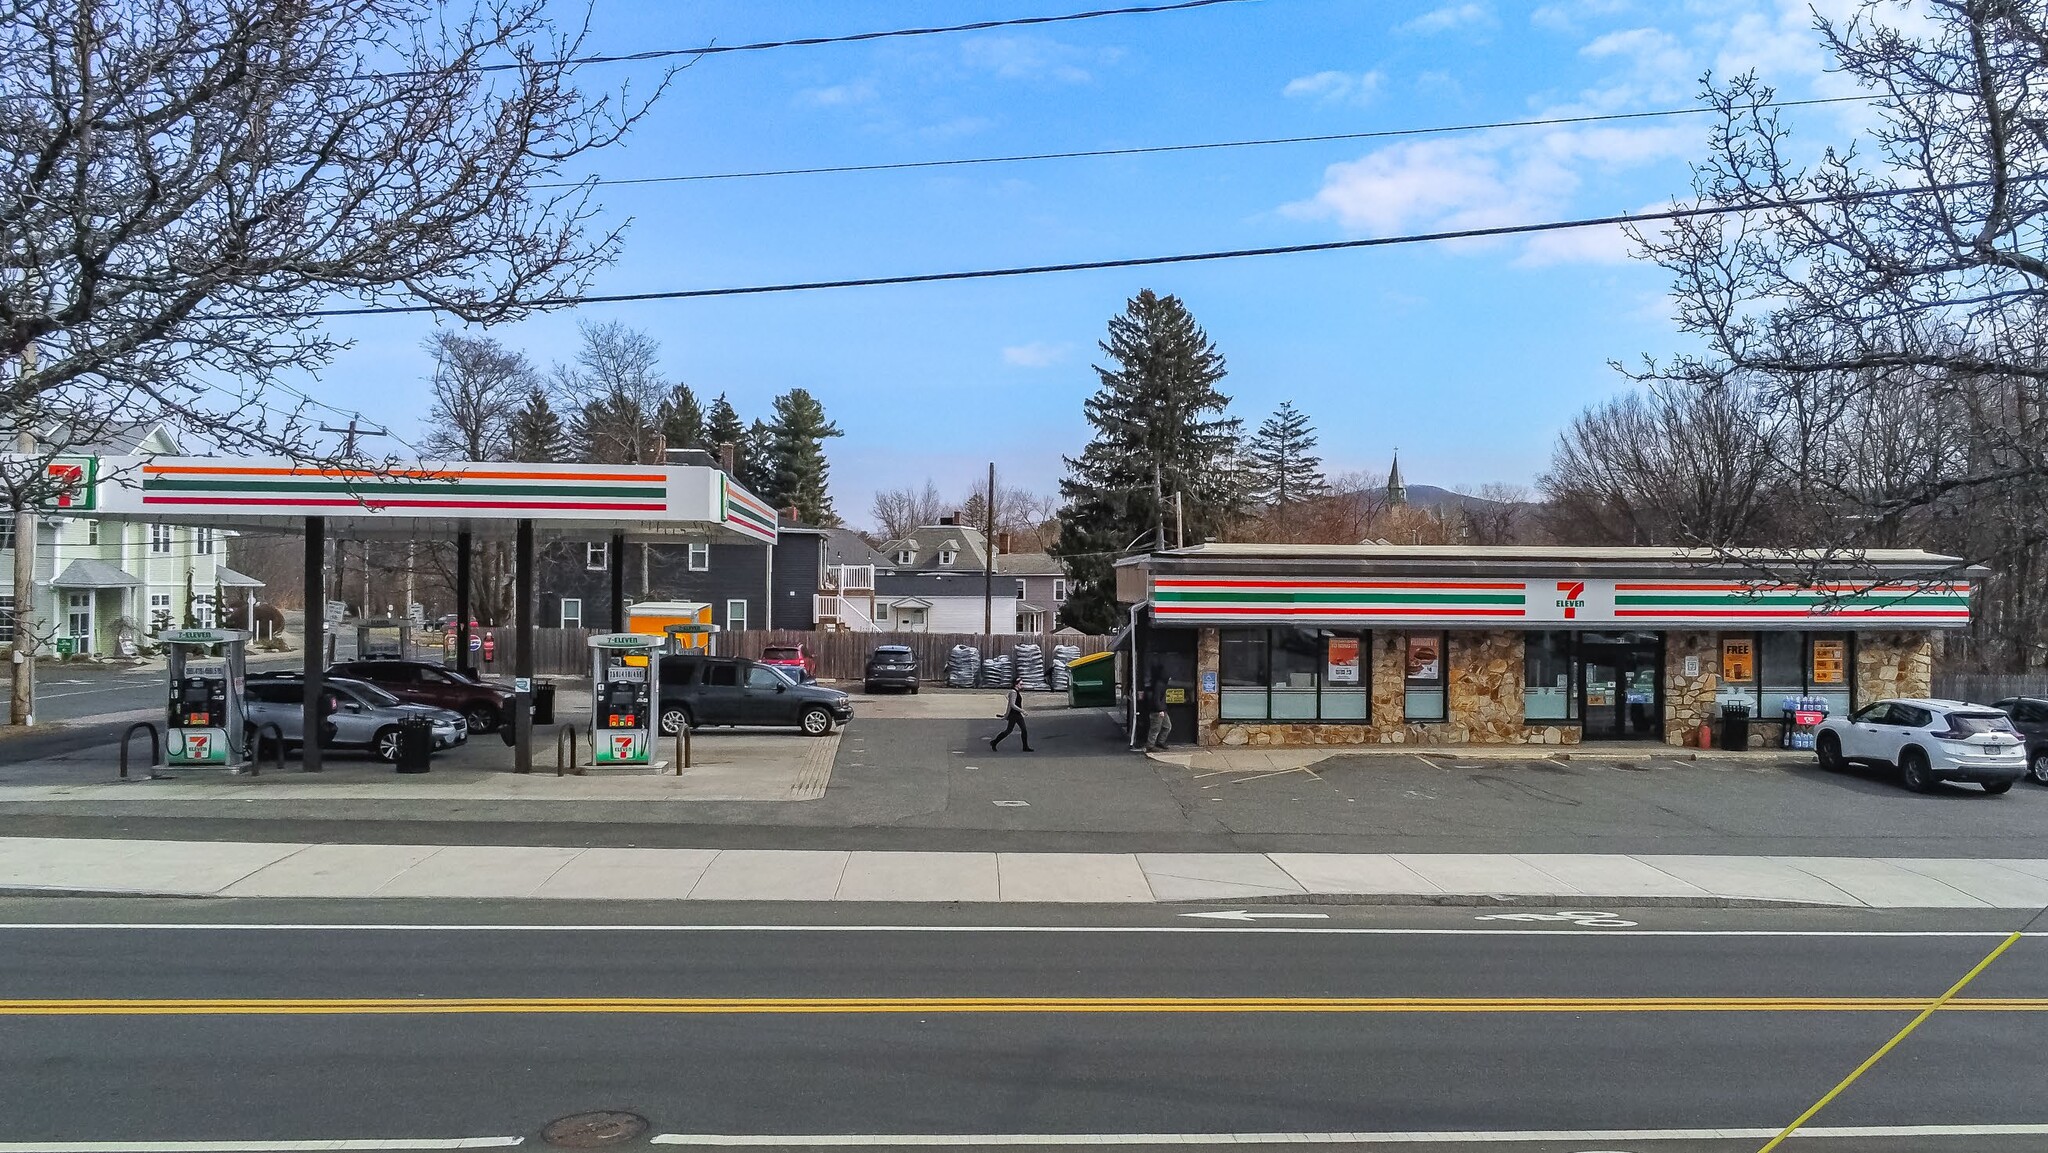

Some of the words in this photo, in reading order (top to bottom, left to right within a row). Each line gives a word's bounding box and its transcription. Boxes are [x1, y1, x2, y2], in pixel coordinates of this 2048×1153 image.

[48, 464, 82, 508] 7
[1556, 581, 1585, 619] 7
[1726, 645, 1749, 654] FREE
[189, 736, 208, 758] 7
[615, 737, 632, 759] 7
